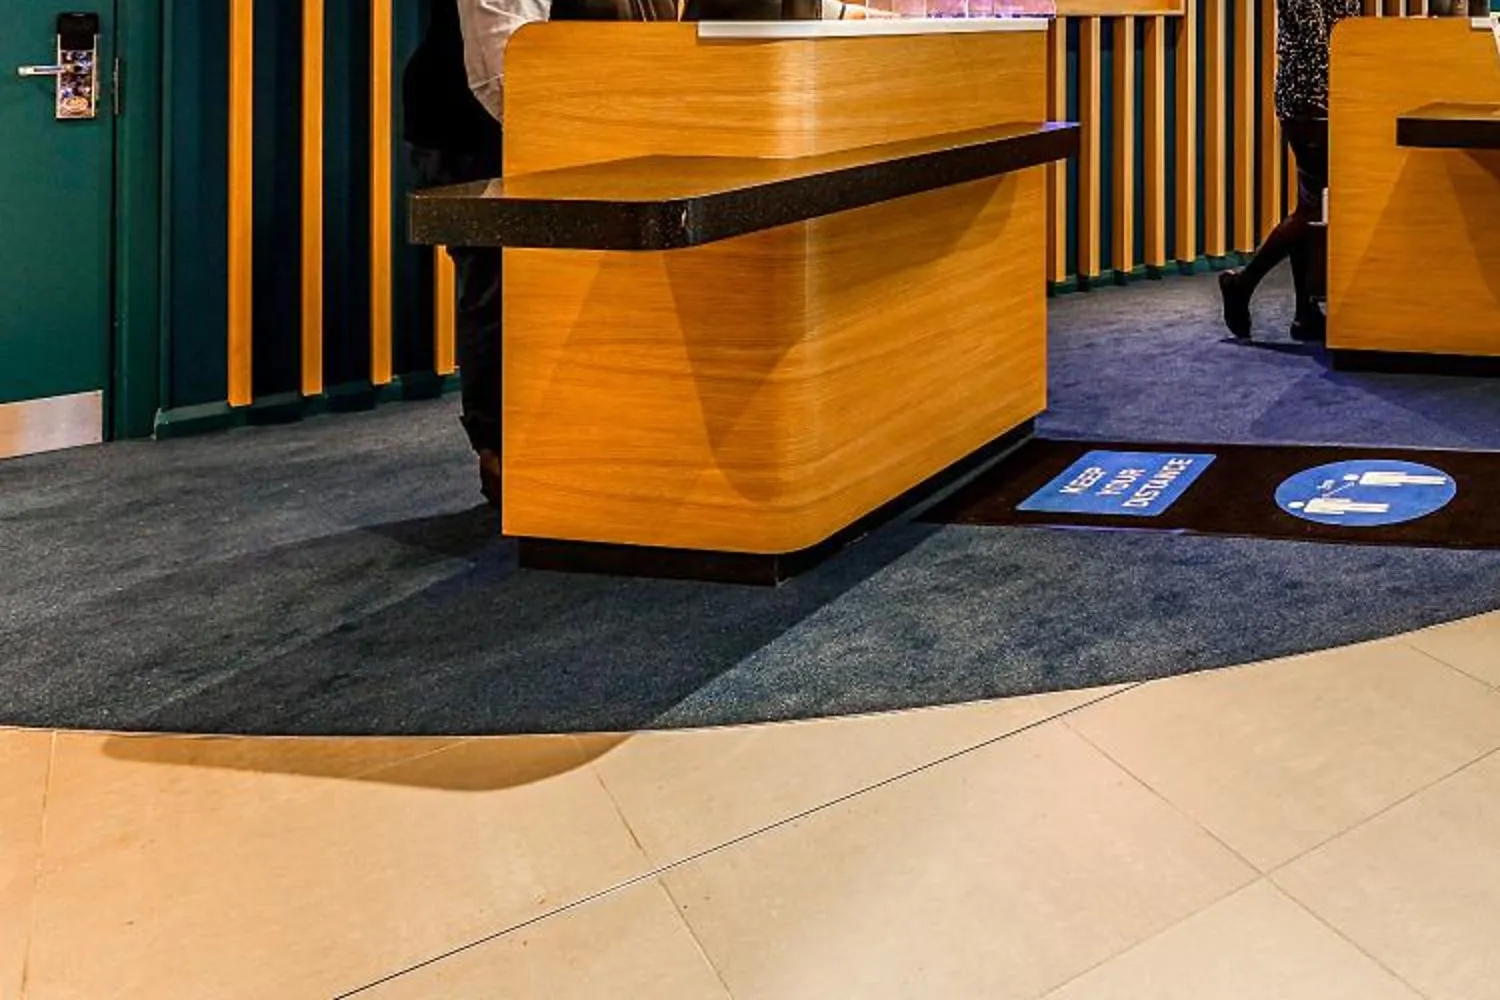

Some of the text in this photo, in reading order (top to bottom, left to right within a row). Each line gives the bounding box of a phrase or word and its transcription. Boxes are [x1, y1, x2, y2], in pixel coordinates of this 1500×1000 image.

[1059, 466, 1106, 494] KEEP
[1095, 468, 1146, 496] YOUR
[1121, 456, 1194, 508] DISTANCE
